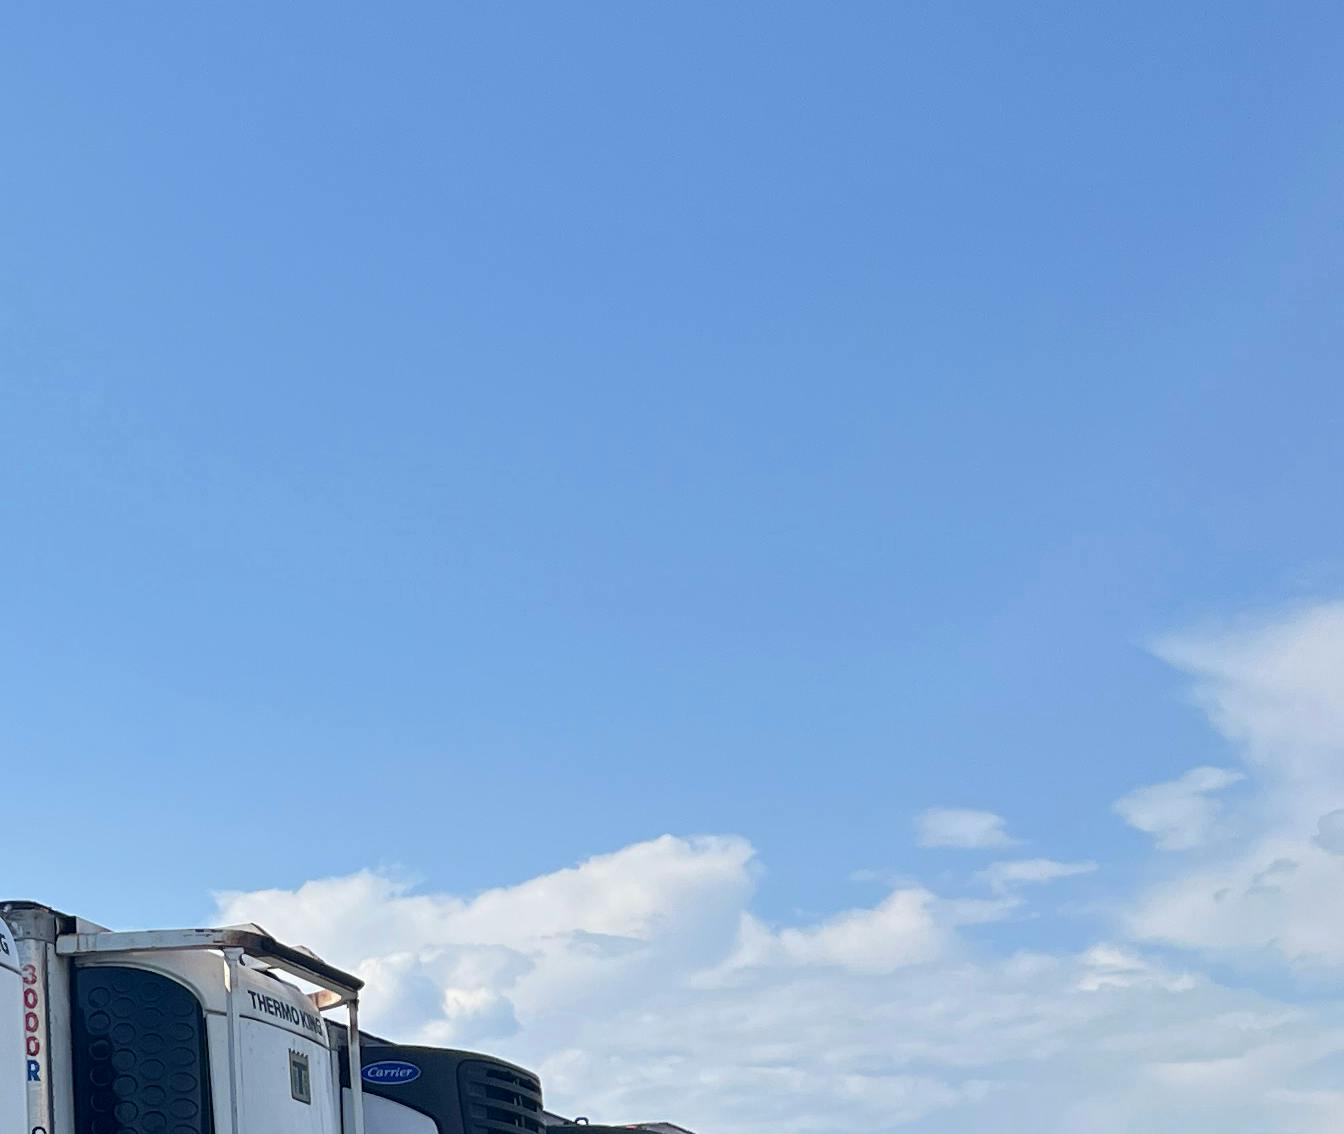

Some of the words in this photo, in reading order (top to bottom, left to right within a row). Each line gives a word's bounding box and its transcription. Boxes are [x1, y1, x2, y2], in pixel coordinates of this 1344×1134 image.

[22, 964, 41, 1082] 3000R
[248, 990, 300, 1026] THERMO
[299, 1010, 323, 1037] KING
[367, 1066, 412, 1077] Carrier
